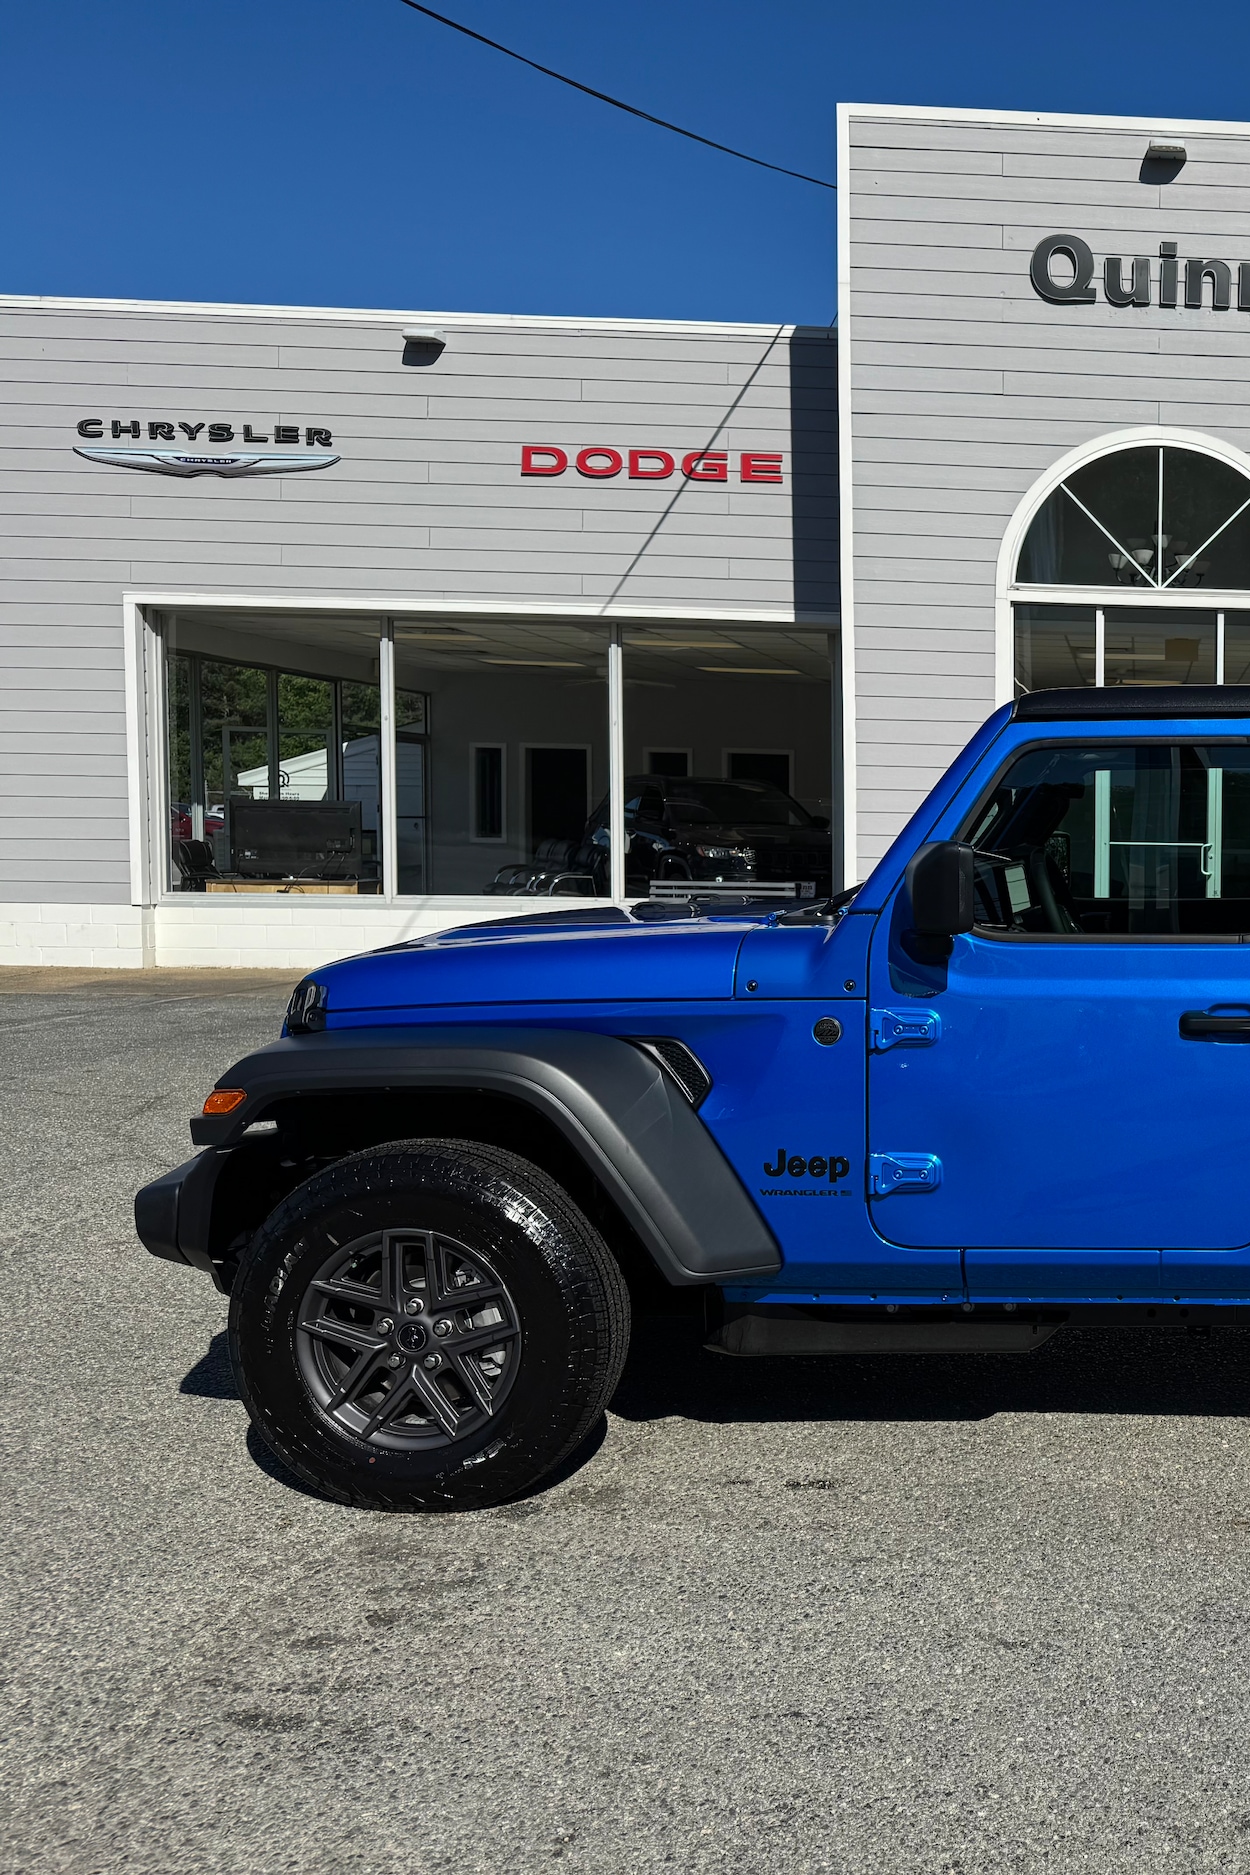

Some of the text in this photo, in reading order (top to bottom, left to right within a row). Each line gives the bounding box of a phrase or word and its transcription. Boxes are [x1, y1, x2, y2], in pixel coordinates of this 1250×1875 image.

[76, 418, 333, 447] CHRYSLER
[521, 445, 783, 483] DODGE
[763, 1148, 850, 1183] Jeep
[760, 1189, 839, 1197] WRANGLER
